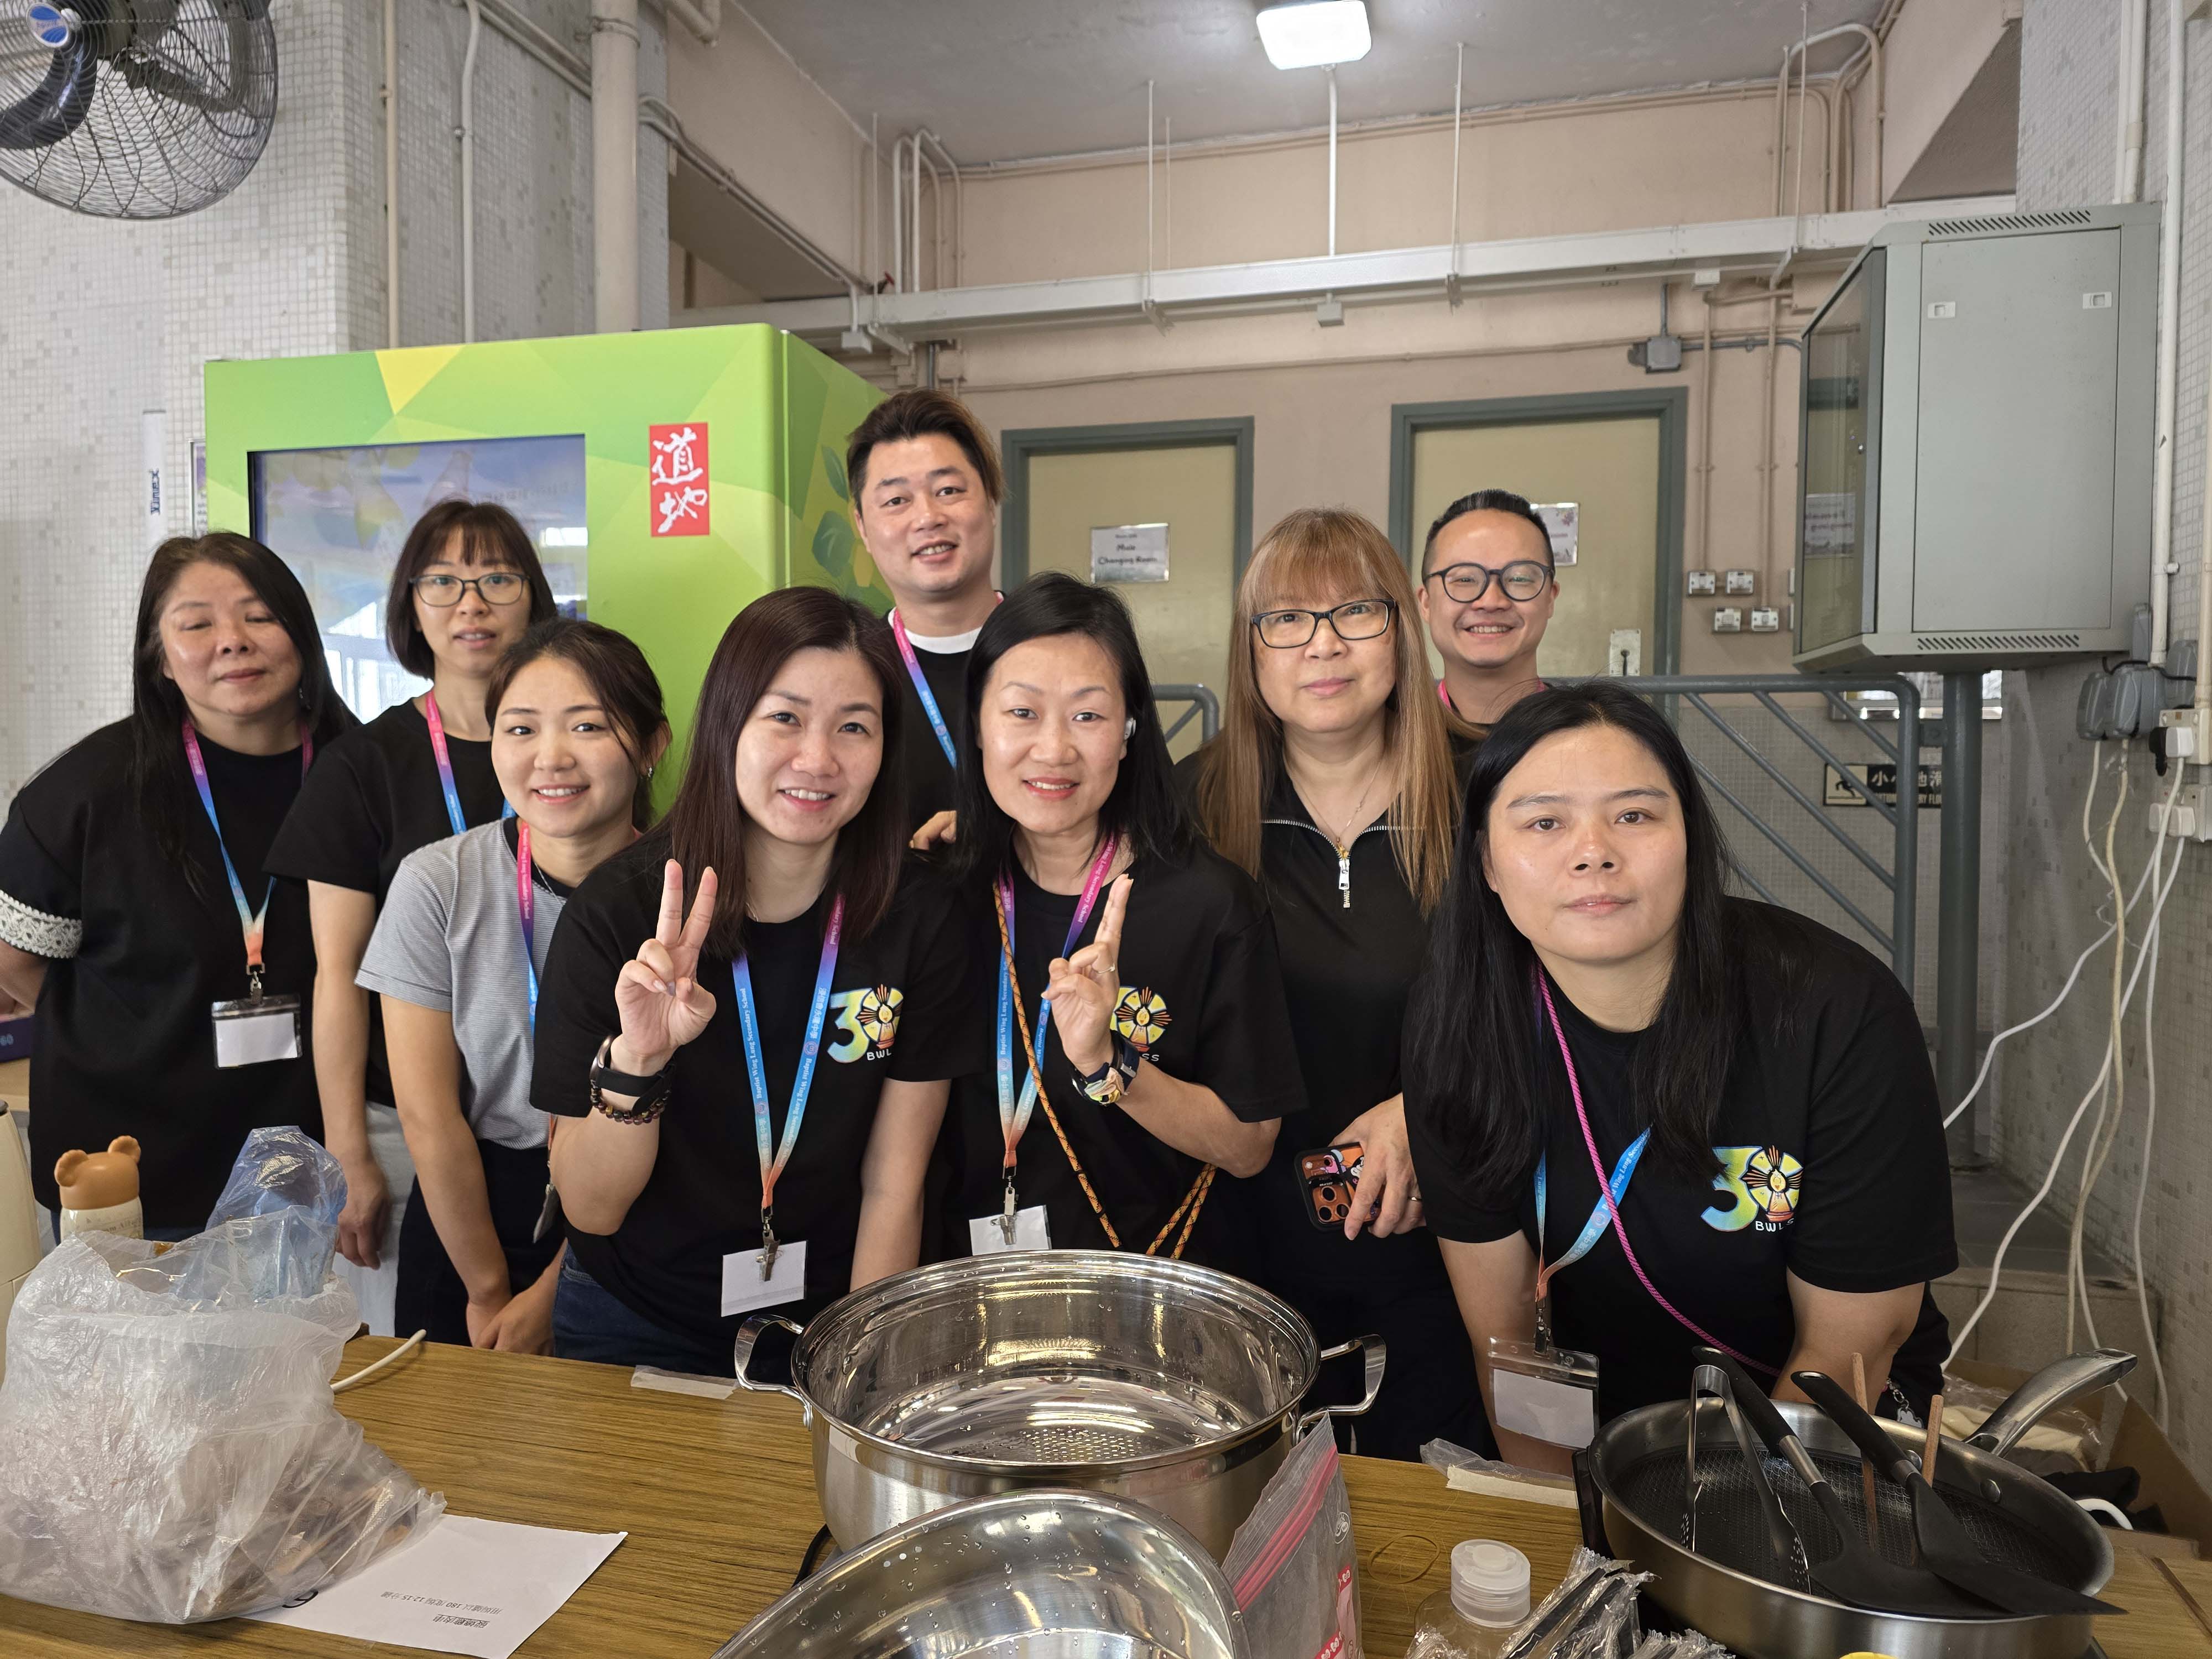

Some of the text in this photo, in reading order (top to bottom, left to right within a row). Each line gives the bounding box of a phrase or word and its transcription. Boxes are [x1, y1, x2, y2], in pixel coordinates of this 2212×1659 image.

[739, 987, 748, 1009] School
[744, 1009, 754, 1042] Secondary
[748, 1041, 757, 1058] Lung
[866, 1048, 892, 1061] BWL
[802, 1058, 812, 1079] Baptist
[754, 1077, 763, 1099] Baptist
[797, 1081, 808, 1098] Wing
[793, 1098, 803, 1115] Lung
[1619, 1157, 1632, 1174] Lung
[1755, 1218, 1794, 1232] BWLS
